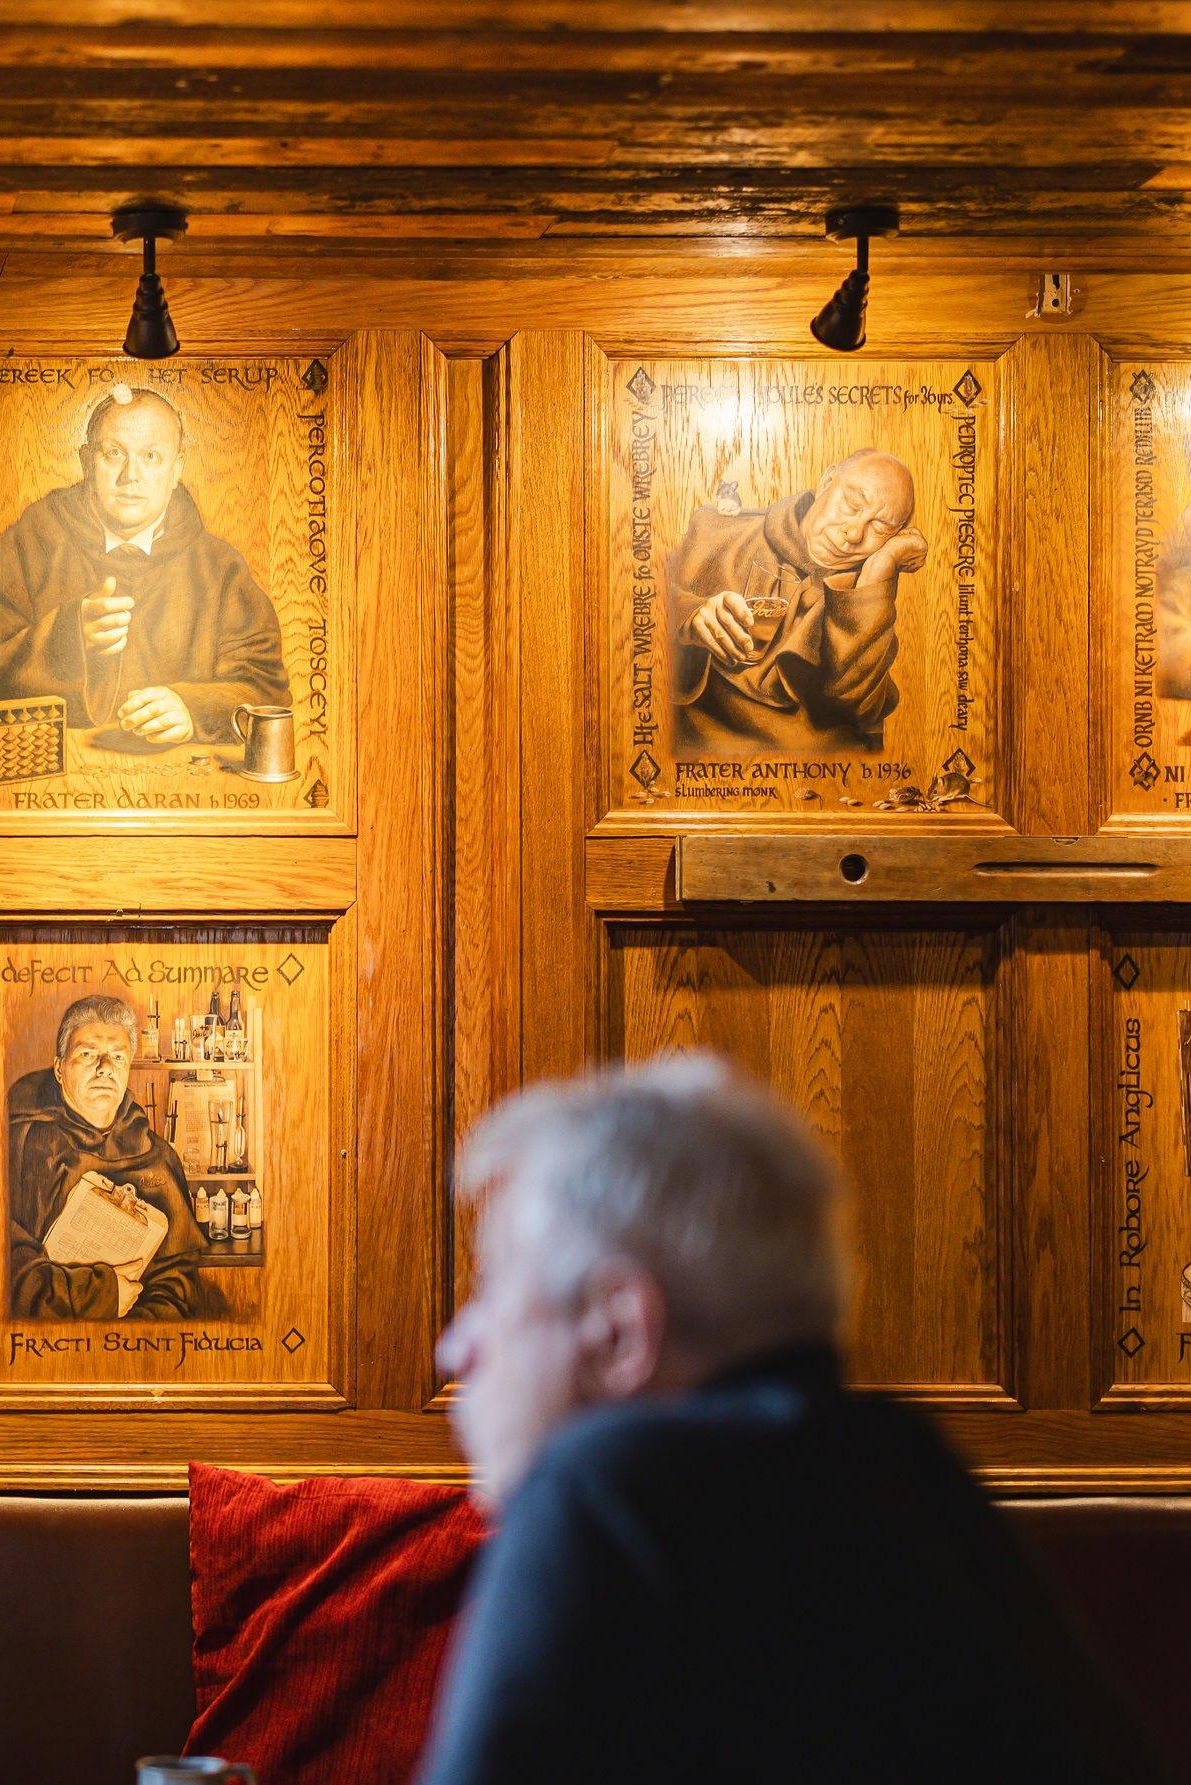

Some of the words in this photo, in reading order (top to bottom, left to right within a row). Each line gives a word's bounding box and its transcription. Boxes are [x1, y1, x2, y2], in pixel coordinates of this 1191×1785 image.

[90, 368, 114, 385] FO
[149, 368, 187, 384] HET
[201, 368, 280, 392] SERUP
[828, 384, 903, 409] SECRETS
[902, 387, 919, 414] for
[632, 411, 657, 502] WREBREY
[951, 415, 976, 504] PEDROPTEC
[632, 507, 652, 562] ONSTE
[948, 508, 975, 577] PIESCRE
[1134, 527, 1160, 598] NOTRAYD
[632, 586, 656, 657] WREBRE
[309, 619, 327, 736] TOSCEYI
[958, 670, 970, 690] saw
[1134, 680, 1153, 697] NI
[949, 695, 974, 731] deary
[1134, 701, 1155, 748] ORNB
[675, 762, 744, 785] FRATER
[751, 762, 851, 785] ANTHONY
[877, 763, 911, 780] 1936
[13, 792, 105, 810] FRATER
[223, 793, 260, 810] 1969
